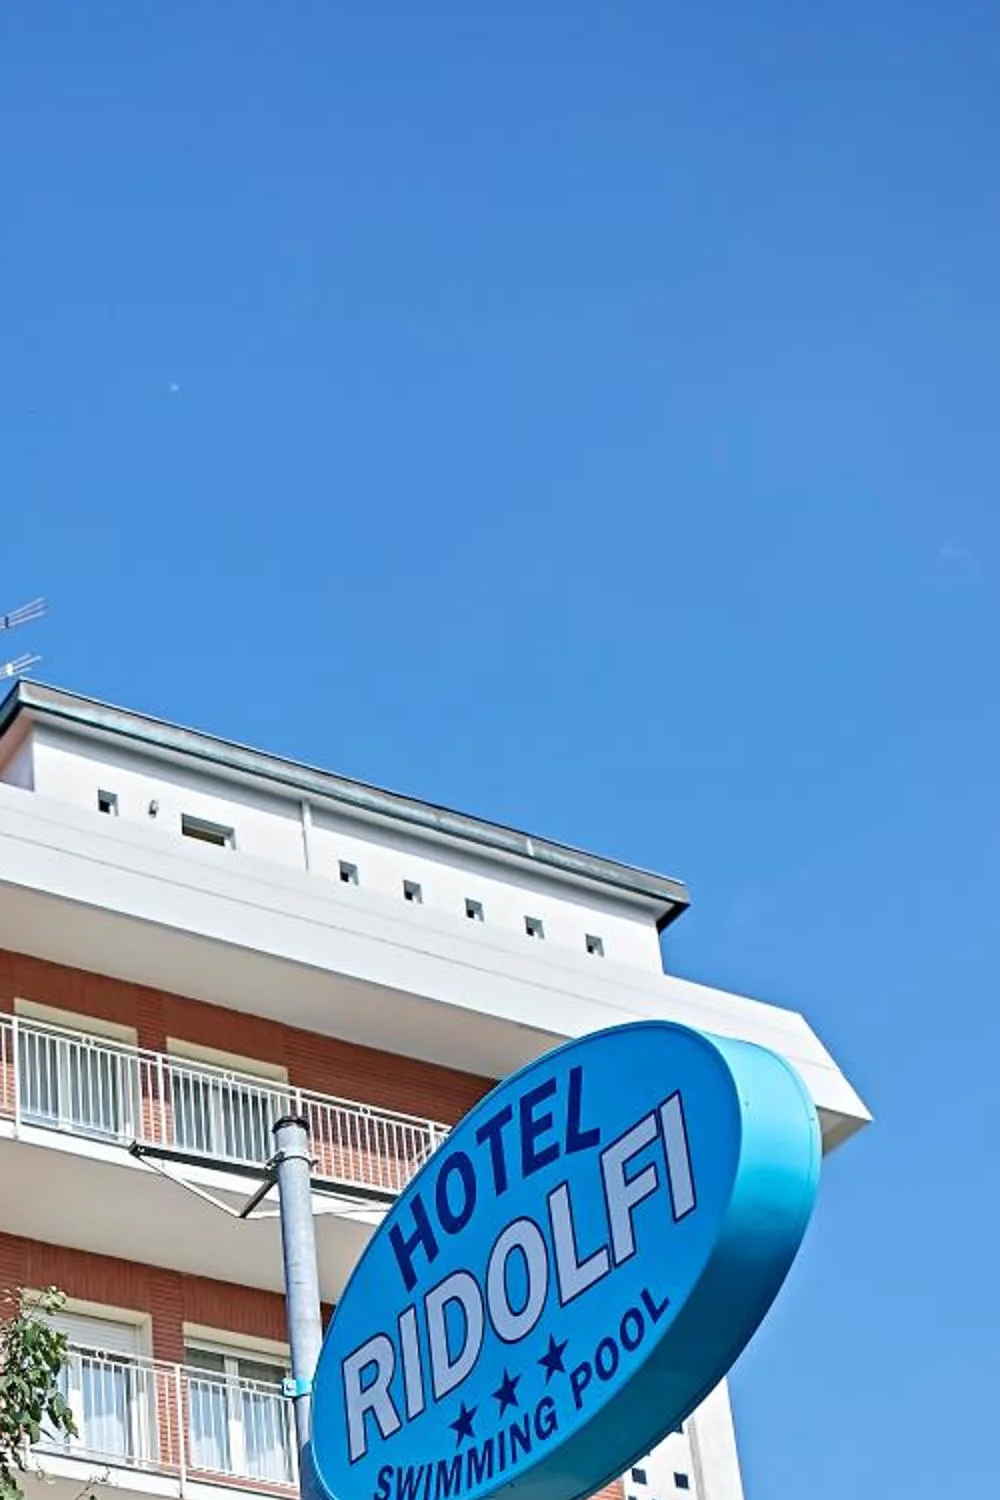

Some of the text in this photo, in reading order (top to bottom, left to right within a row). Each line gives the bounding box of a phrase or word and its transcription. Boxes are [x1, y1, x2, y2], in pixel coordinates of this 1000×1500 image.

[341, 1089, 697, 1464] RIDOLFI
[389, 1066, 601, 1291] HOTEL
[569, 1287, 670, 1409] POOL
